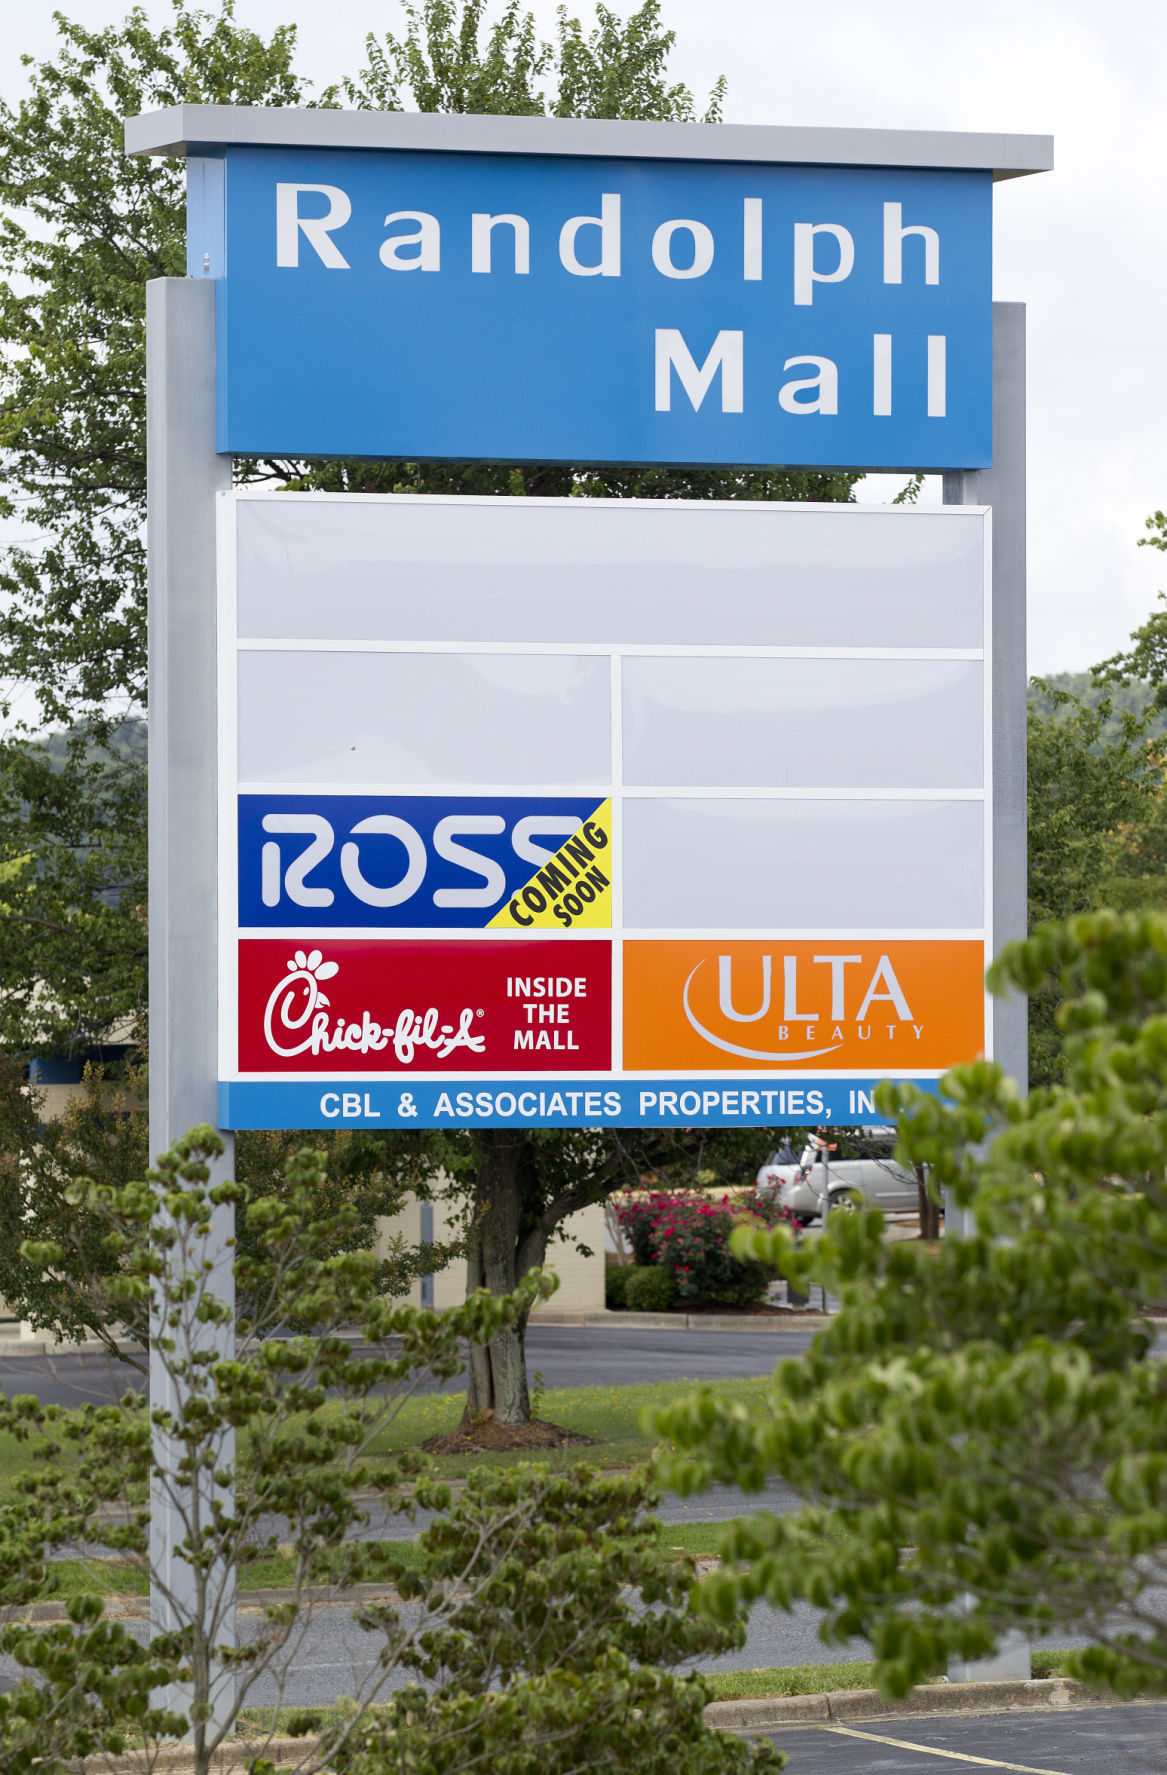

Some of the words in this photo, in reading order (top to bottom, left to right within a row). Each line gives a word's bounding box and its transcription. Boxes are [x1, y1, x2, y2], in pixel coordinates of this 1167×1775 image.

[276, 183, 940, 306] Randolph
[655, 328, 947, 418] Mall
[509, 822, 608, 926] COMING
[553, 865, 610, 927] SOON
[506, 977, 587, 998] INSIDE
[718, 955, 914, 1023] ULTA
[523, 1003, 570, 1024] THE
[778, 1025, 924, 1041] BEAUTY
[513, 1030, 580, 1050] MALL
[320, 1092, 381, 1118] CBL
[397, 1092, 418, 1118] &
[433, 1091, 622, 1117] ASSOCIATES
[639, 1090, 832, 1119] PROPERTIES,
